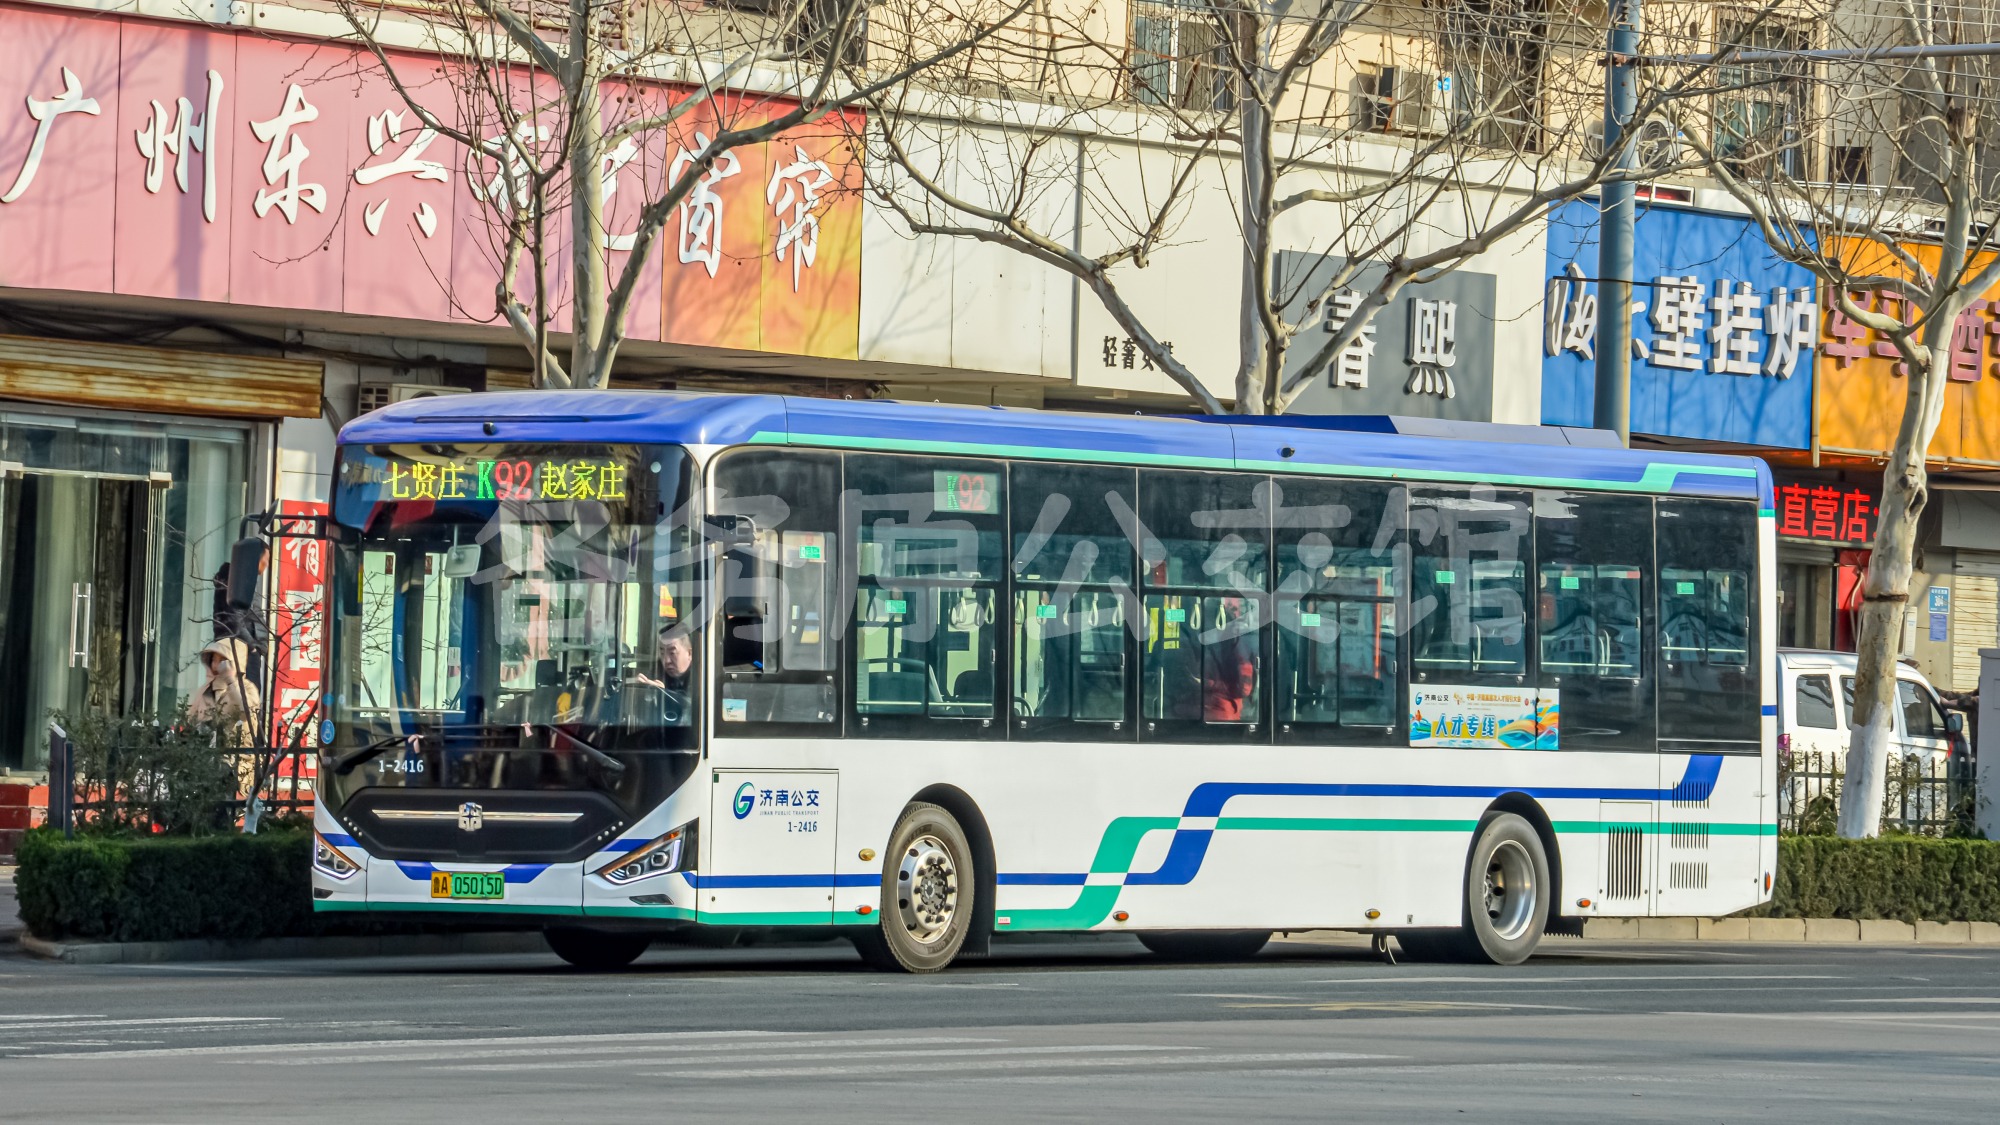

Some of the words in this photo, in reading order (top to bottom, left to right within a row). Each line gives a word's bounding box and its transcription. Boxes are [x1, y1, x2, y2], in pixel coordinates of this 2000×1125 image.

[1546, 262, 1817, 380] 海壁挂炉
[1102, 335, 1174, 372] 轻奢女
[382, 461, 466, 500] 七贤庄
[476, 460, 532, 500] K92
[540, 461, 625, 500] 赵家庄
[946, 474, 985, 511] K92
[1773, 483, 1872, 543] 直营店
[1435, 713, 1496, 737] 人才专线
[378, 759, 424, 773] 1-2416
[760, 789, 820, 807] 济南公交
[788, 821, 818, 833] 1-2416
